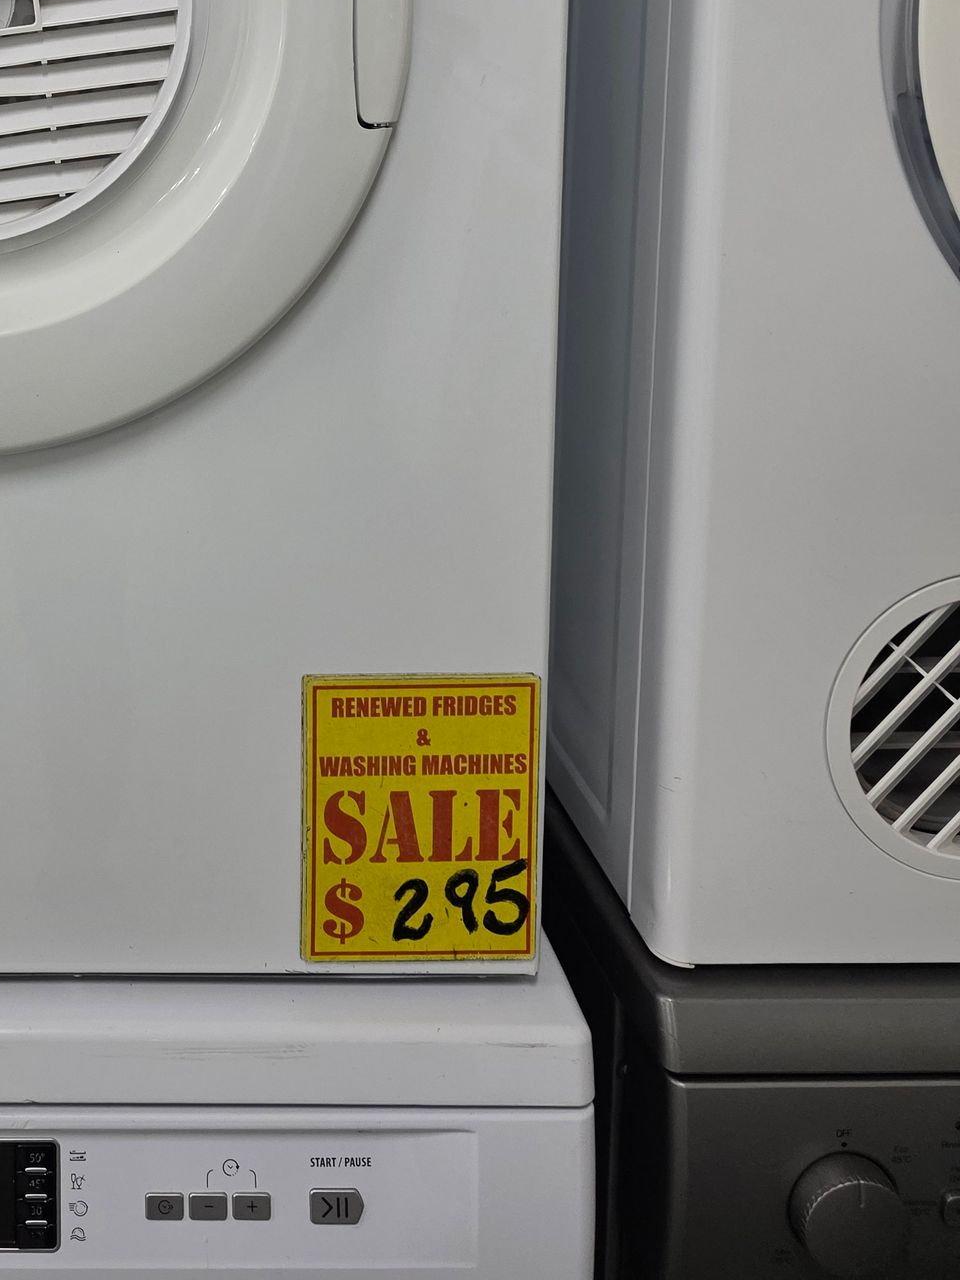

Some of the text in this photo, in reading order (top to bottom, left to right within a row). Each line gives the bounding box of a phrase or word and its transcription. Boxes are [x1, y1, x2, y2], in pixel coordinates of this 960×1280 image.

[331, 695, 517, 718] RENEWED FRIDGES
[416, 728, 431, 746] &
[319, 753, 528, 777] WASHING MACHINES
[323, 789, 521, 865] SALE
[322, 858, 531, 945] $ 295
[310, 1157, 337, 1167] START
[344, 1157, 371, 1167] PAUSE
